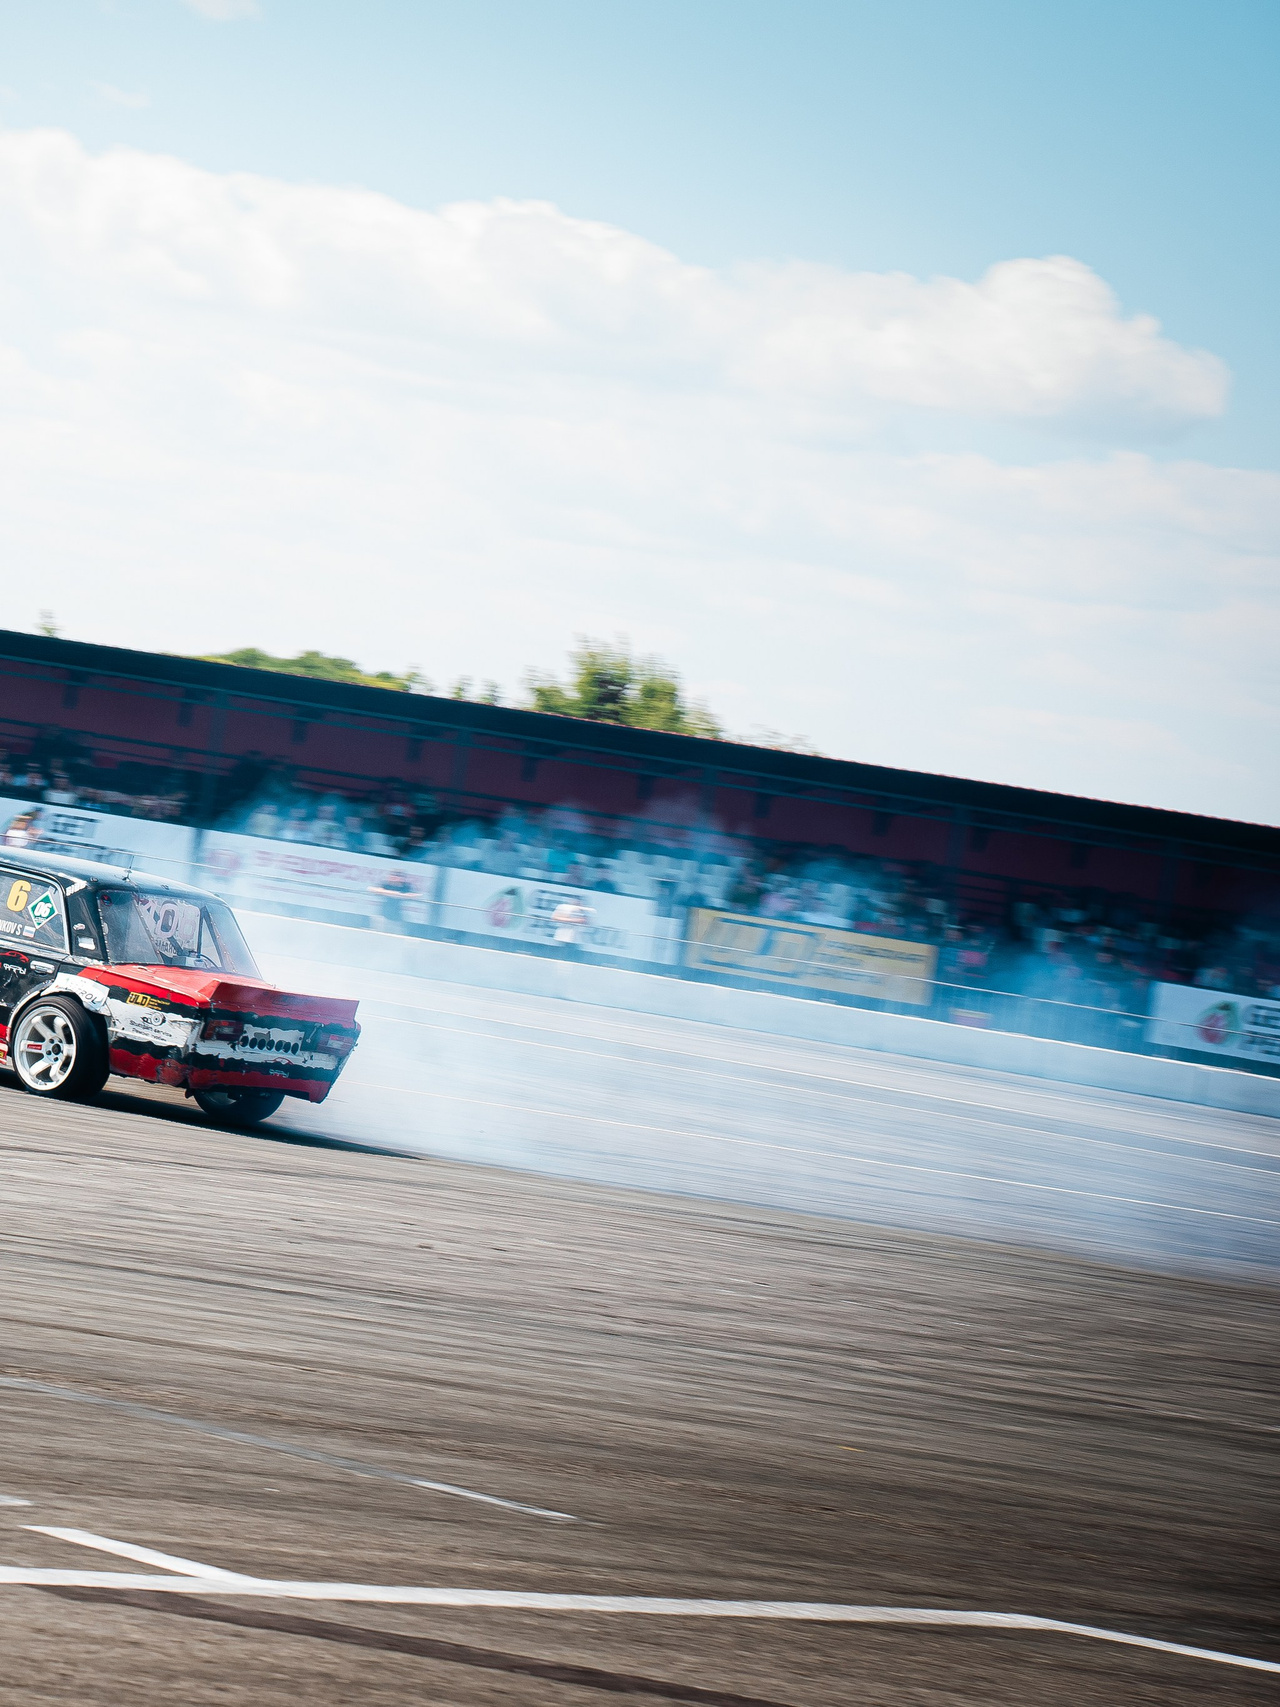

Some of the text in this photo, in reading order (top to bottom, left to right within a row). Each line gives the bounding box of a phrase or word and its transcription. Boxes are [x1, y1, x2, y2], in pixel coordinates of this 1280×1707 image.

[7, 879, 32, 912] 6
[33, 901, 53, 918] 06
[15, 924, 23, 936] S
